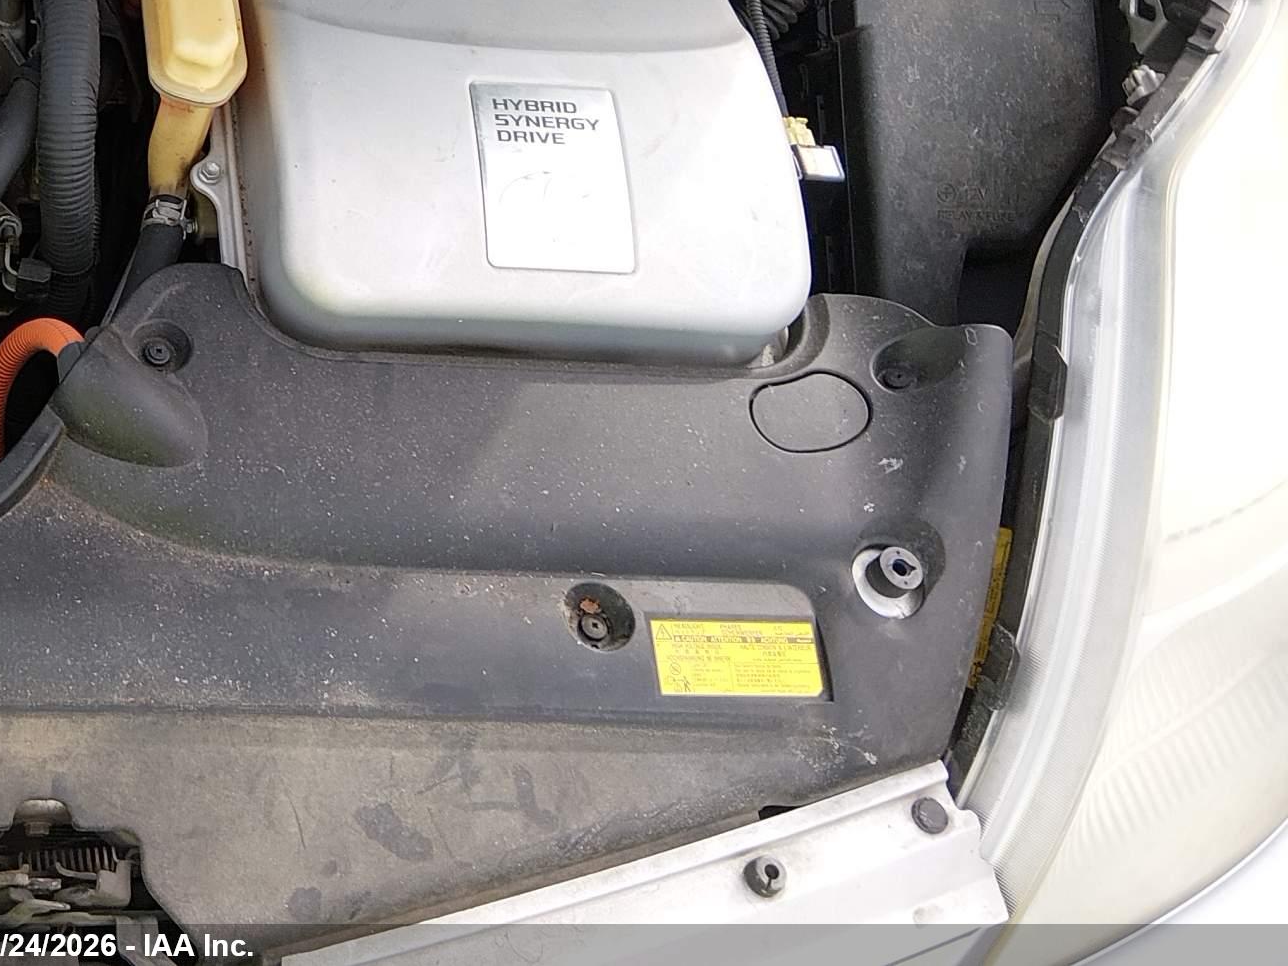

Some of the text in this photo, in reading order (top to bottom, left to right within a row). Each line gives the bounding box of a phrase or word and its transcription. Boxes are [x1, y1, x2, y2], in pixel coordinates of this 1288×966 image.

[492, 98, 577, 114] HYBRID
[495, 114, 600, 131] SYNERGY
[497, 130, 566, 145] DRIVE
